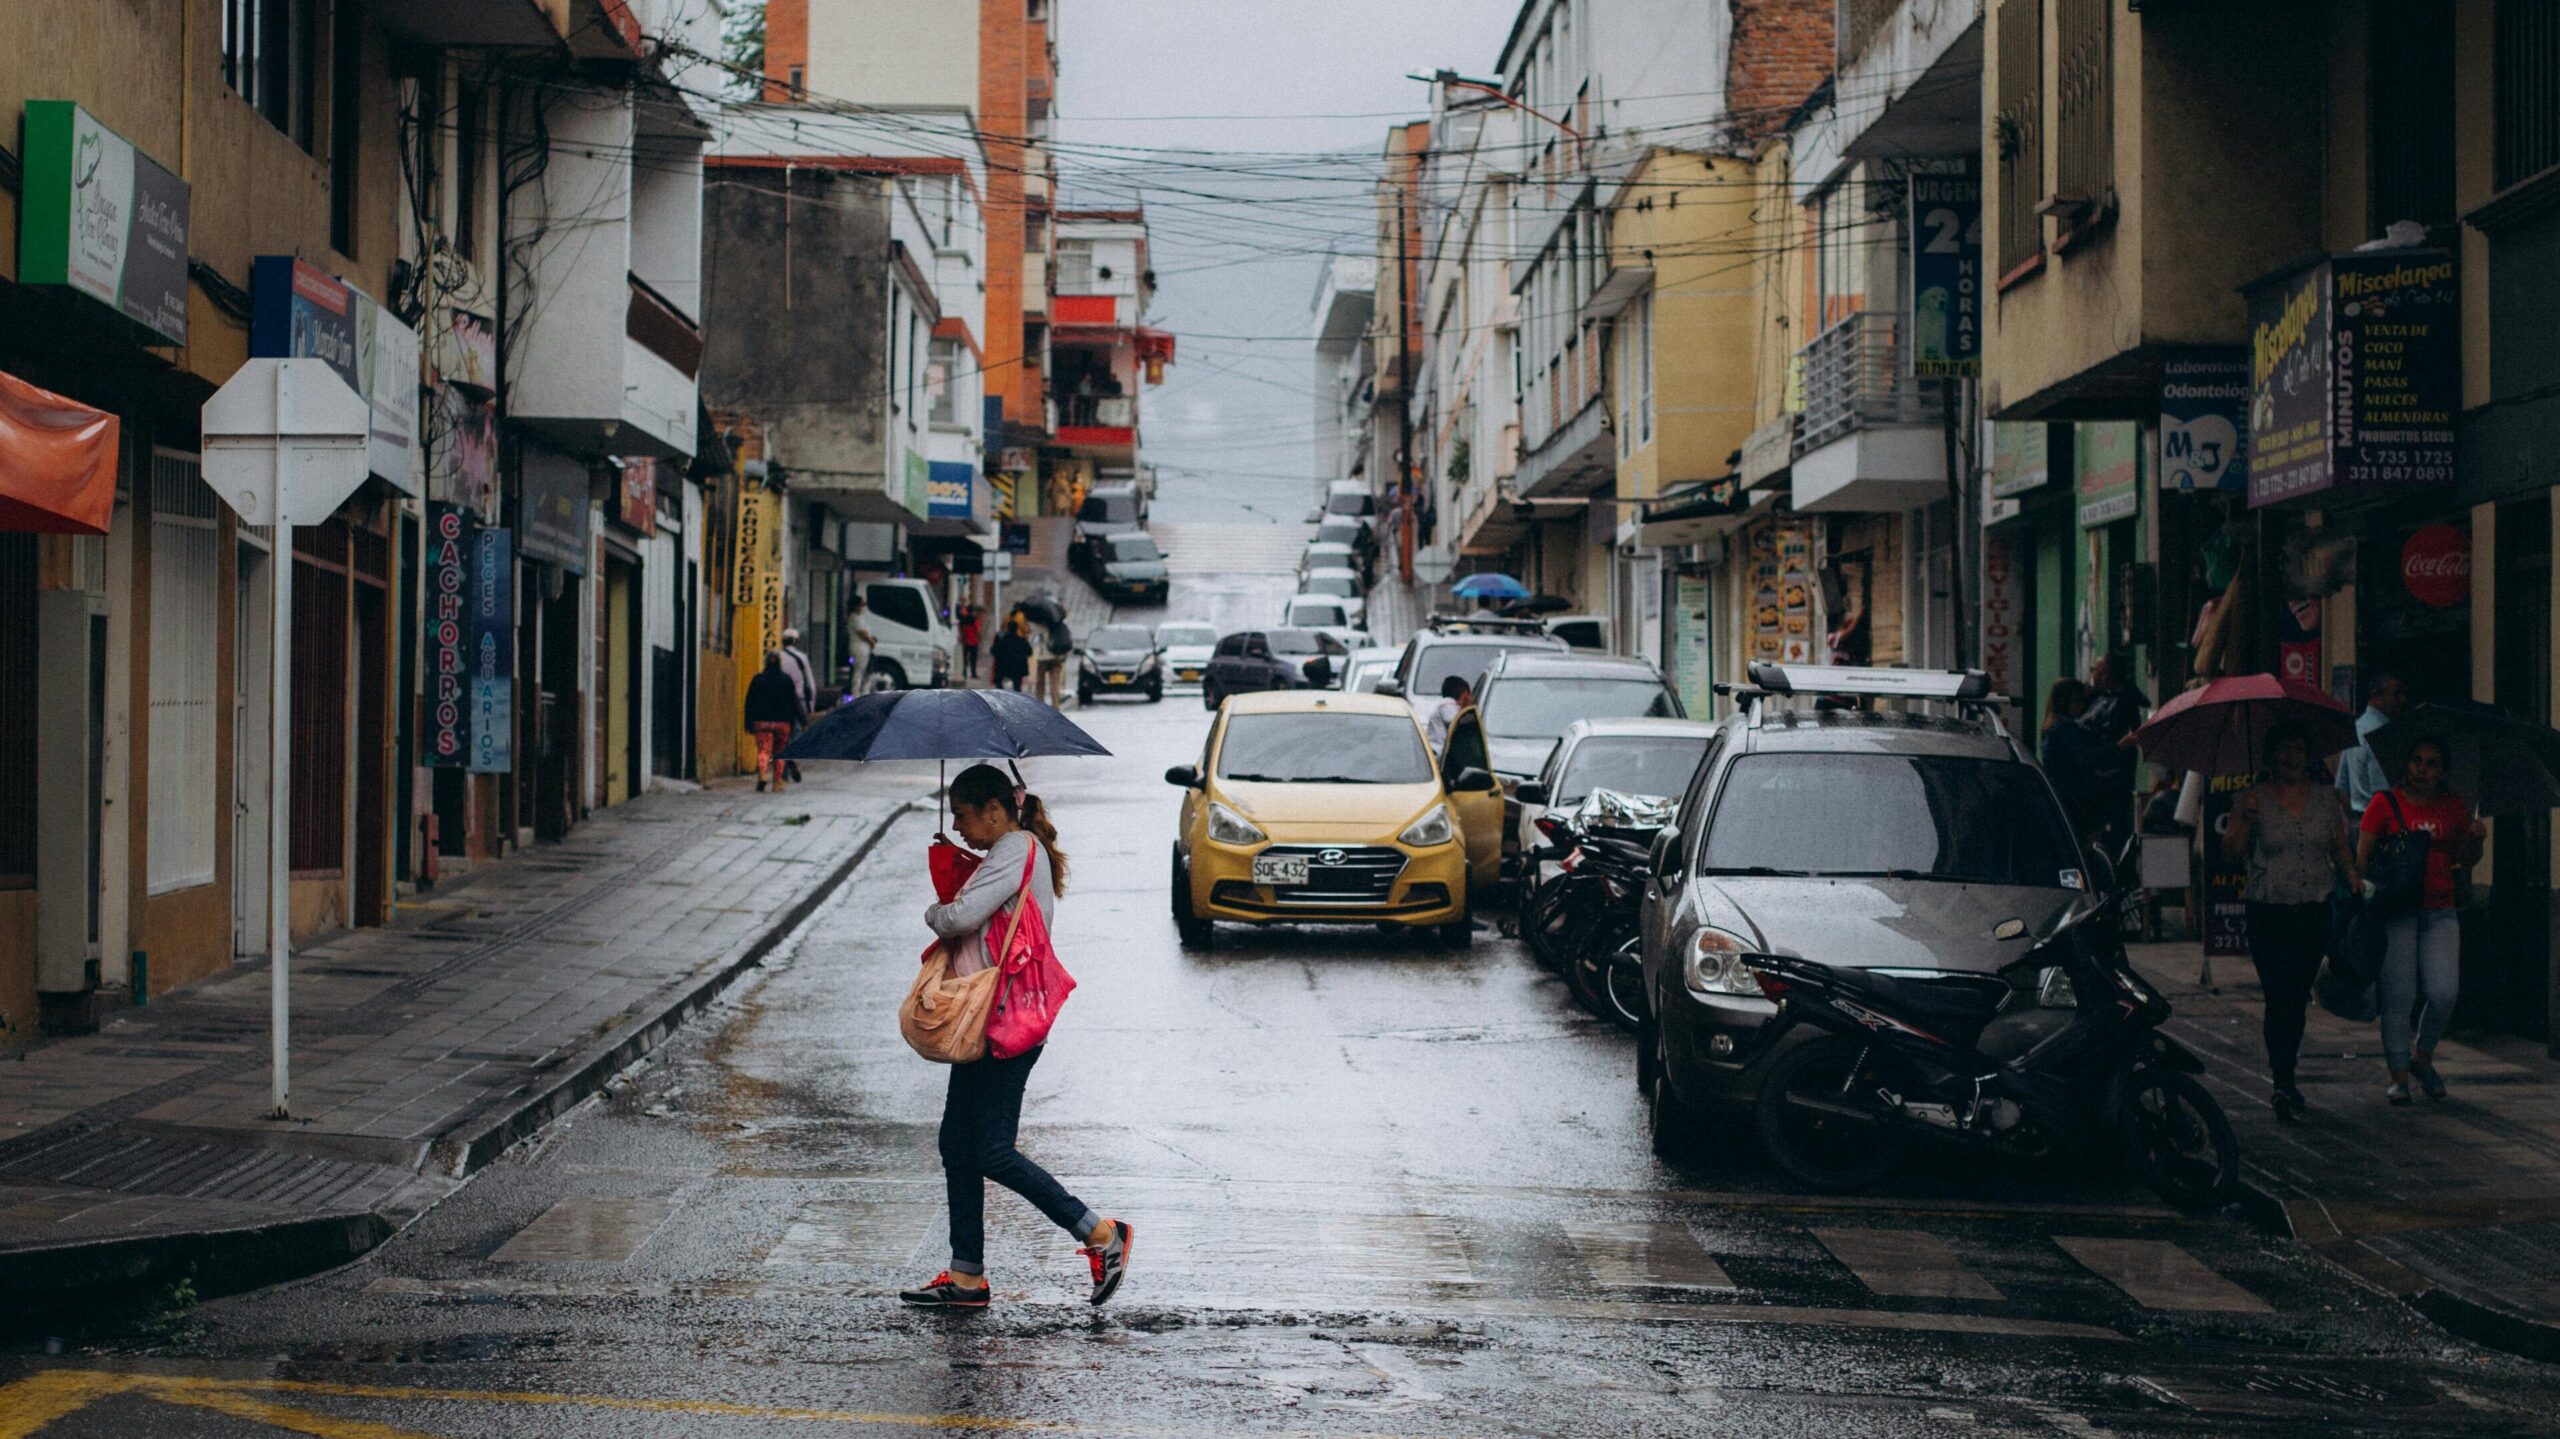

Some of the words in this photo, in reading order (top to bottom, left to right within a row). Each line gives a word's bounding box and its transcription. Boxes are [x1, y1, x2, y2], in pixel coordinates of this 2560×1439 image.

[1917, 180, 1982, 202] URGEN
[1958, 259, 1975, 352] HORAS
[2363, 325, 2406, 337] VENTA
[2411, 325, 2429, 337] DE
[2363, 342, 2404, 354] COCO
[2363, 357, 2403, 371] MANÍ
[2338, 330, 2356, 448] MINUTOS
[2363, 376, 2409, 388] PASAS
[2163, 383, 2249, 402] Odontológ
[2363, 394, 2418, 406] NUECES
[2363, 411, 2449, 423] ALMENDRAS
[2358, 430, 2420, 444] PRODUCTOS
[2422, 430, 2455, 443] SECOS
[2377, 451, 2408, 464] 735
[2414, 451, 2454, 465] 1725
[2349, 466, 2378, 480] 321
[2382, 466, 2413, 480] 847
[2416, 466, 2455, 481] 0891
[481, 533, 497, 617] PECES
[437, 513, 462, 756] CACHORROS
[480, 631, 498, 767] ACUARIOS
[1281, 862, 1307, 878] 432
